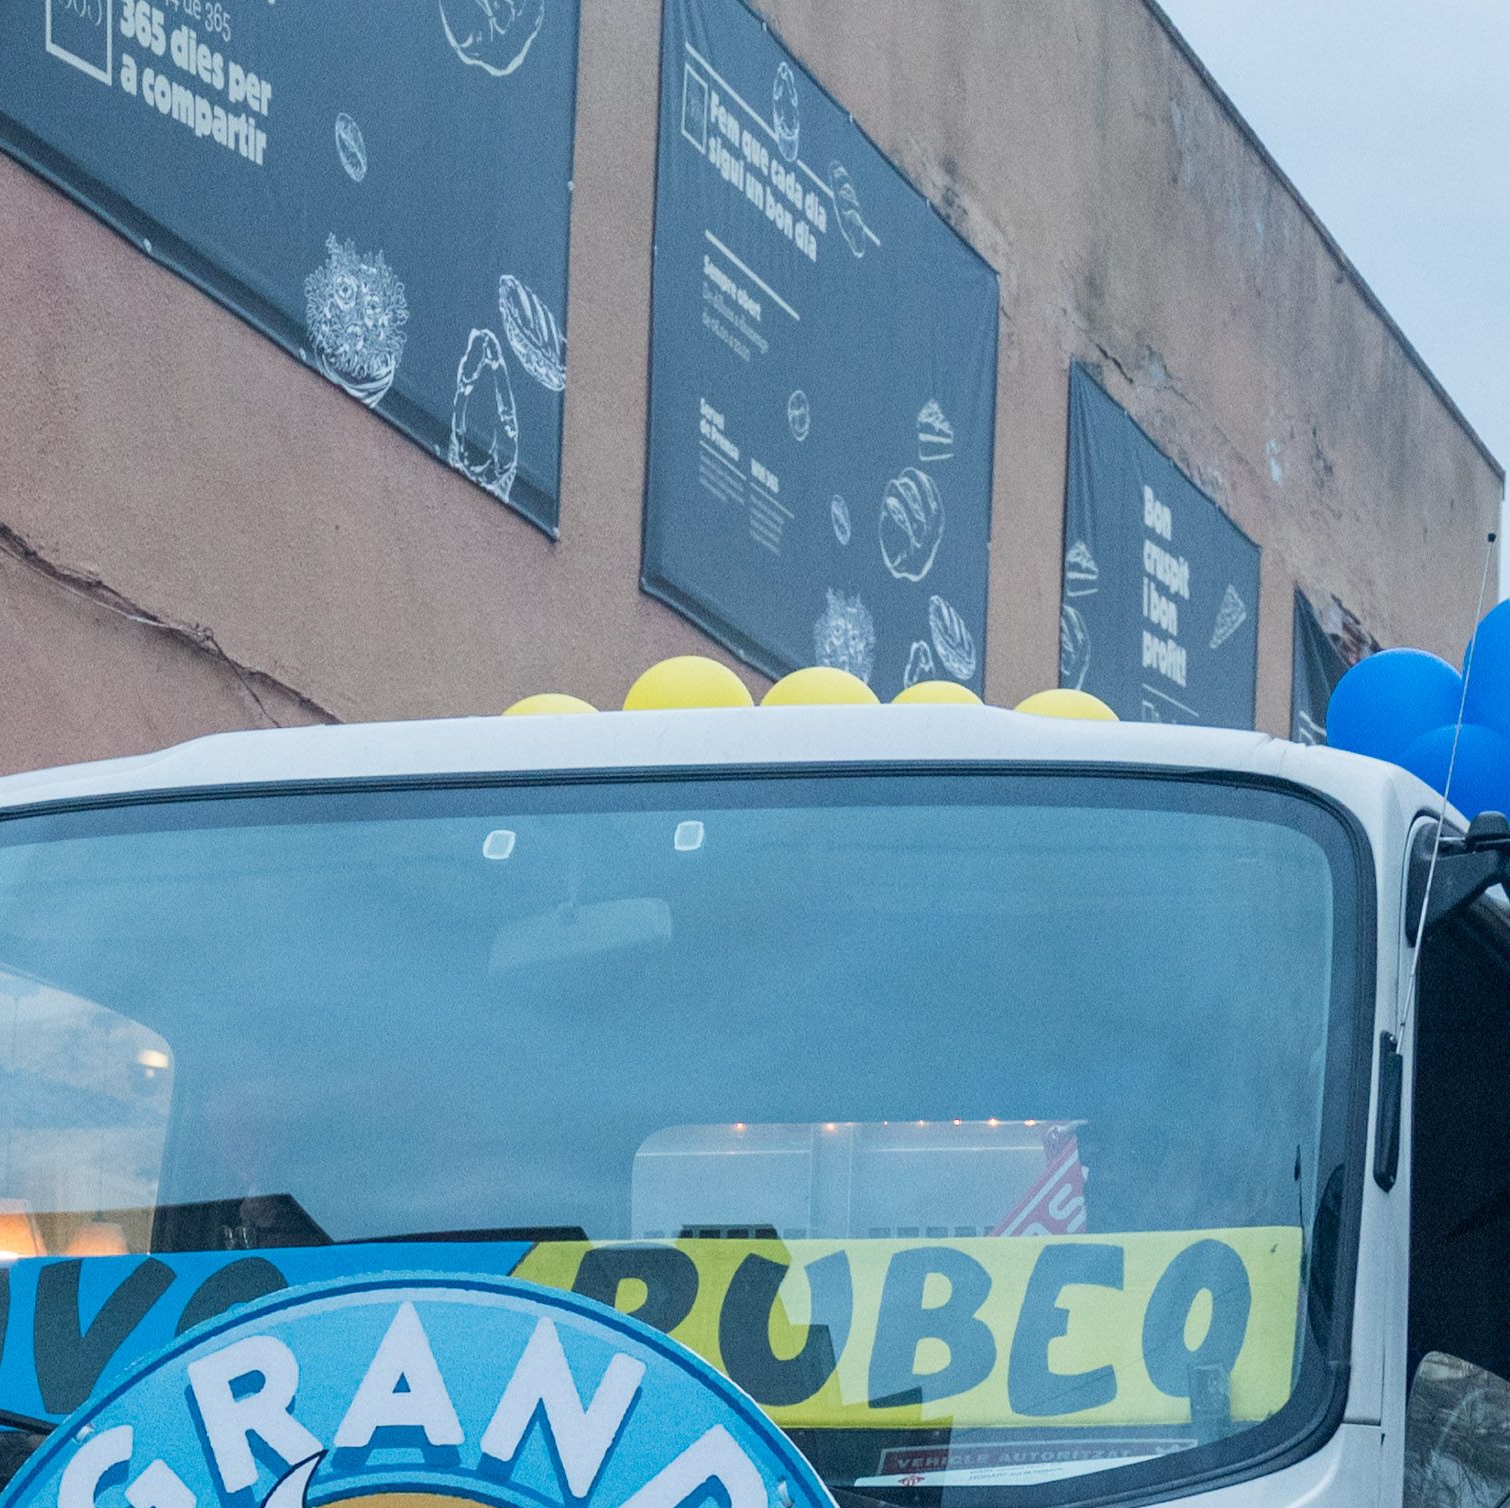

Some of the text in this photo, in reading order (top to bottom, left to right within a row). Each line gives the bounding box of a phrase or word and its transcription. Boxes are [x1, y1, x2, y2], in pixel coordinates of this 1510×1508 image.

[120, 0, 166, 56] 365
[170, 24, 224, 90] dies
[228, 61, 272, 117] per
[204, 2, 231, 42] 365
[120, 53, 267, 167] a compartir
[710, 89, 826, 233] Fem que cada dia
[709, 136, 817, 263] sigui un bon dia
[1144, 485, 1172, 541] Bon
[1150, 581, 1178, 636] bon
